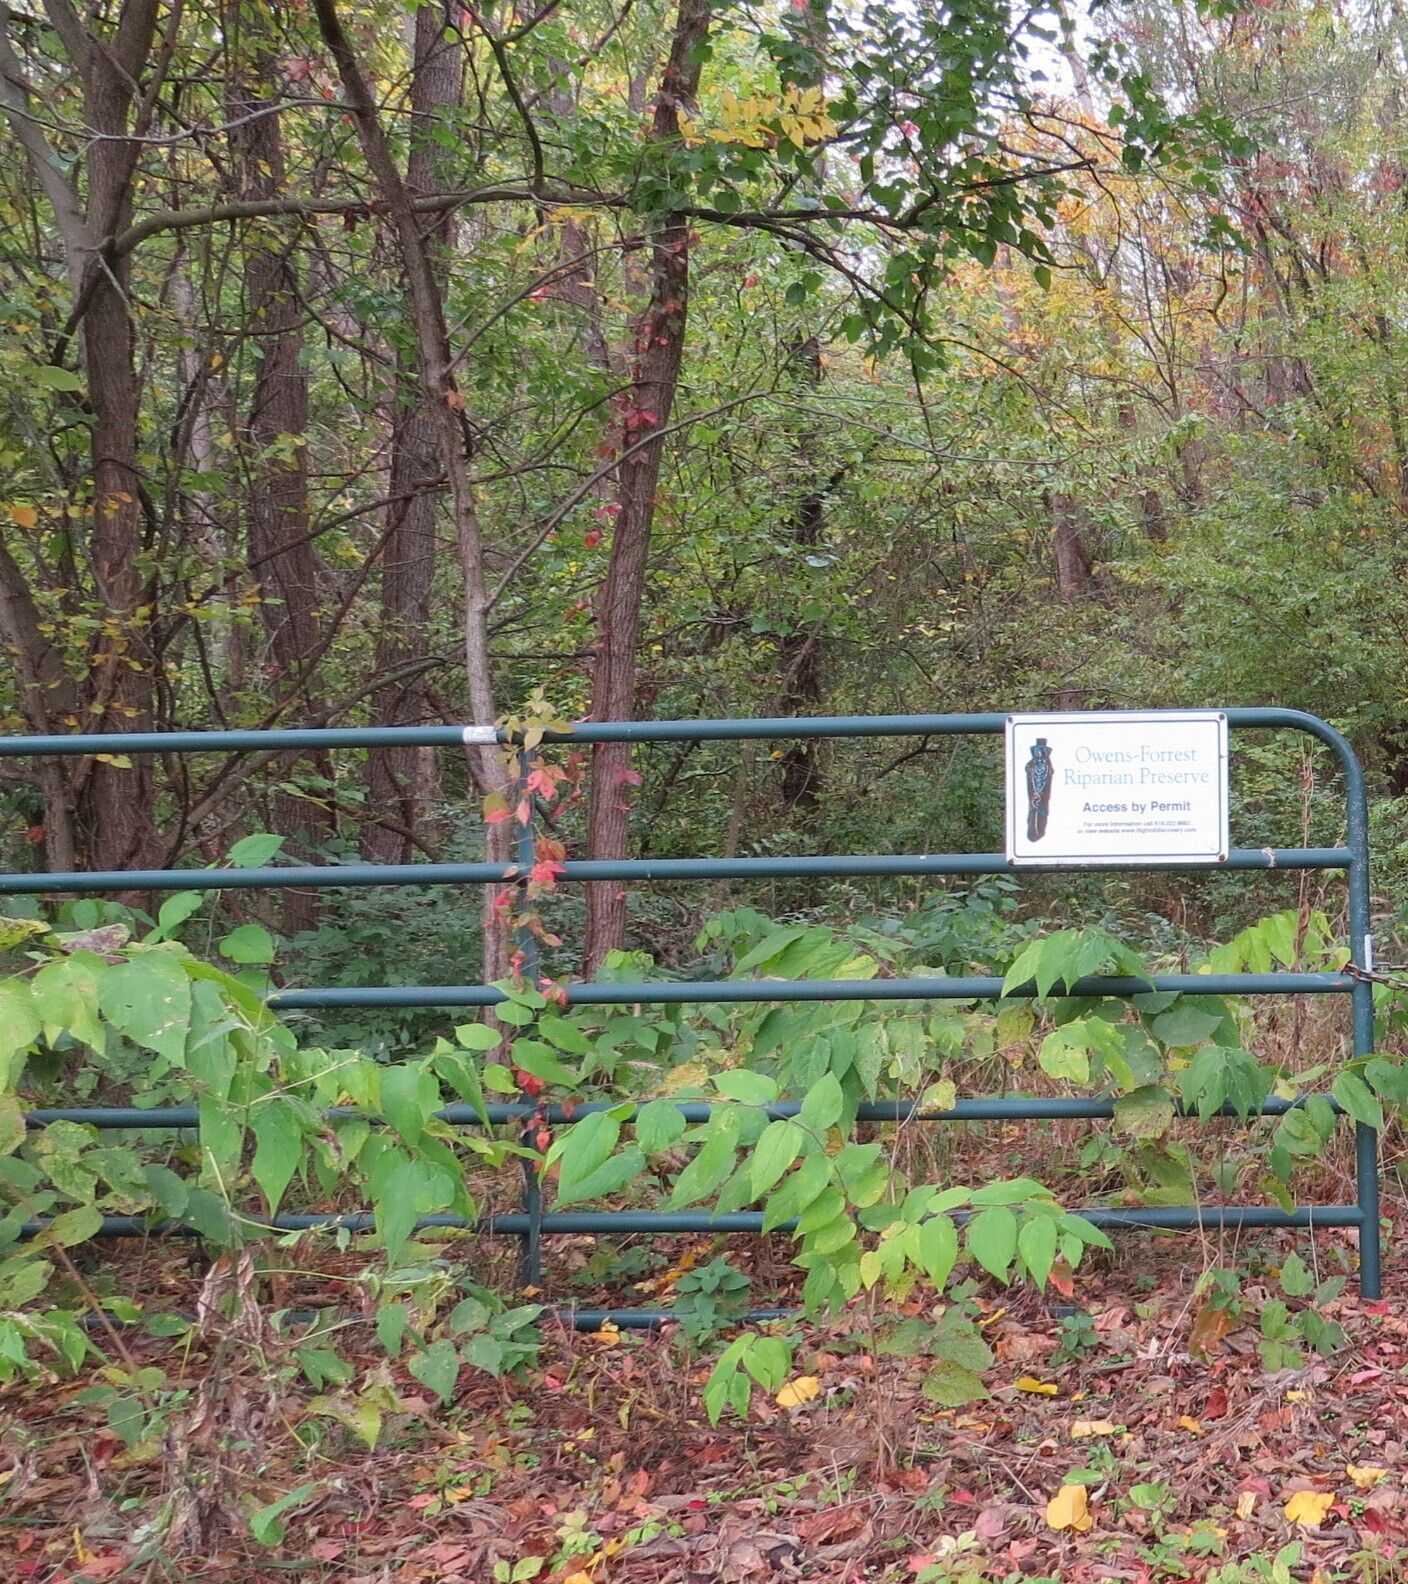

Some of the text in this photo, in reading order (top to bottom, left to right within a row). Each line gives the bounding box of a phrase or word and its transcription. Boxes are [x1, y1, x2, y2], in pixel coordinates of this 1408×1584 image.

[1075, 745, 1198, 763] Owens-Forrest
[1064, 767, 1209, 789] Riparian Preserve
[1083, 801, 1191, 814] Access by Permit
